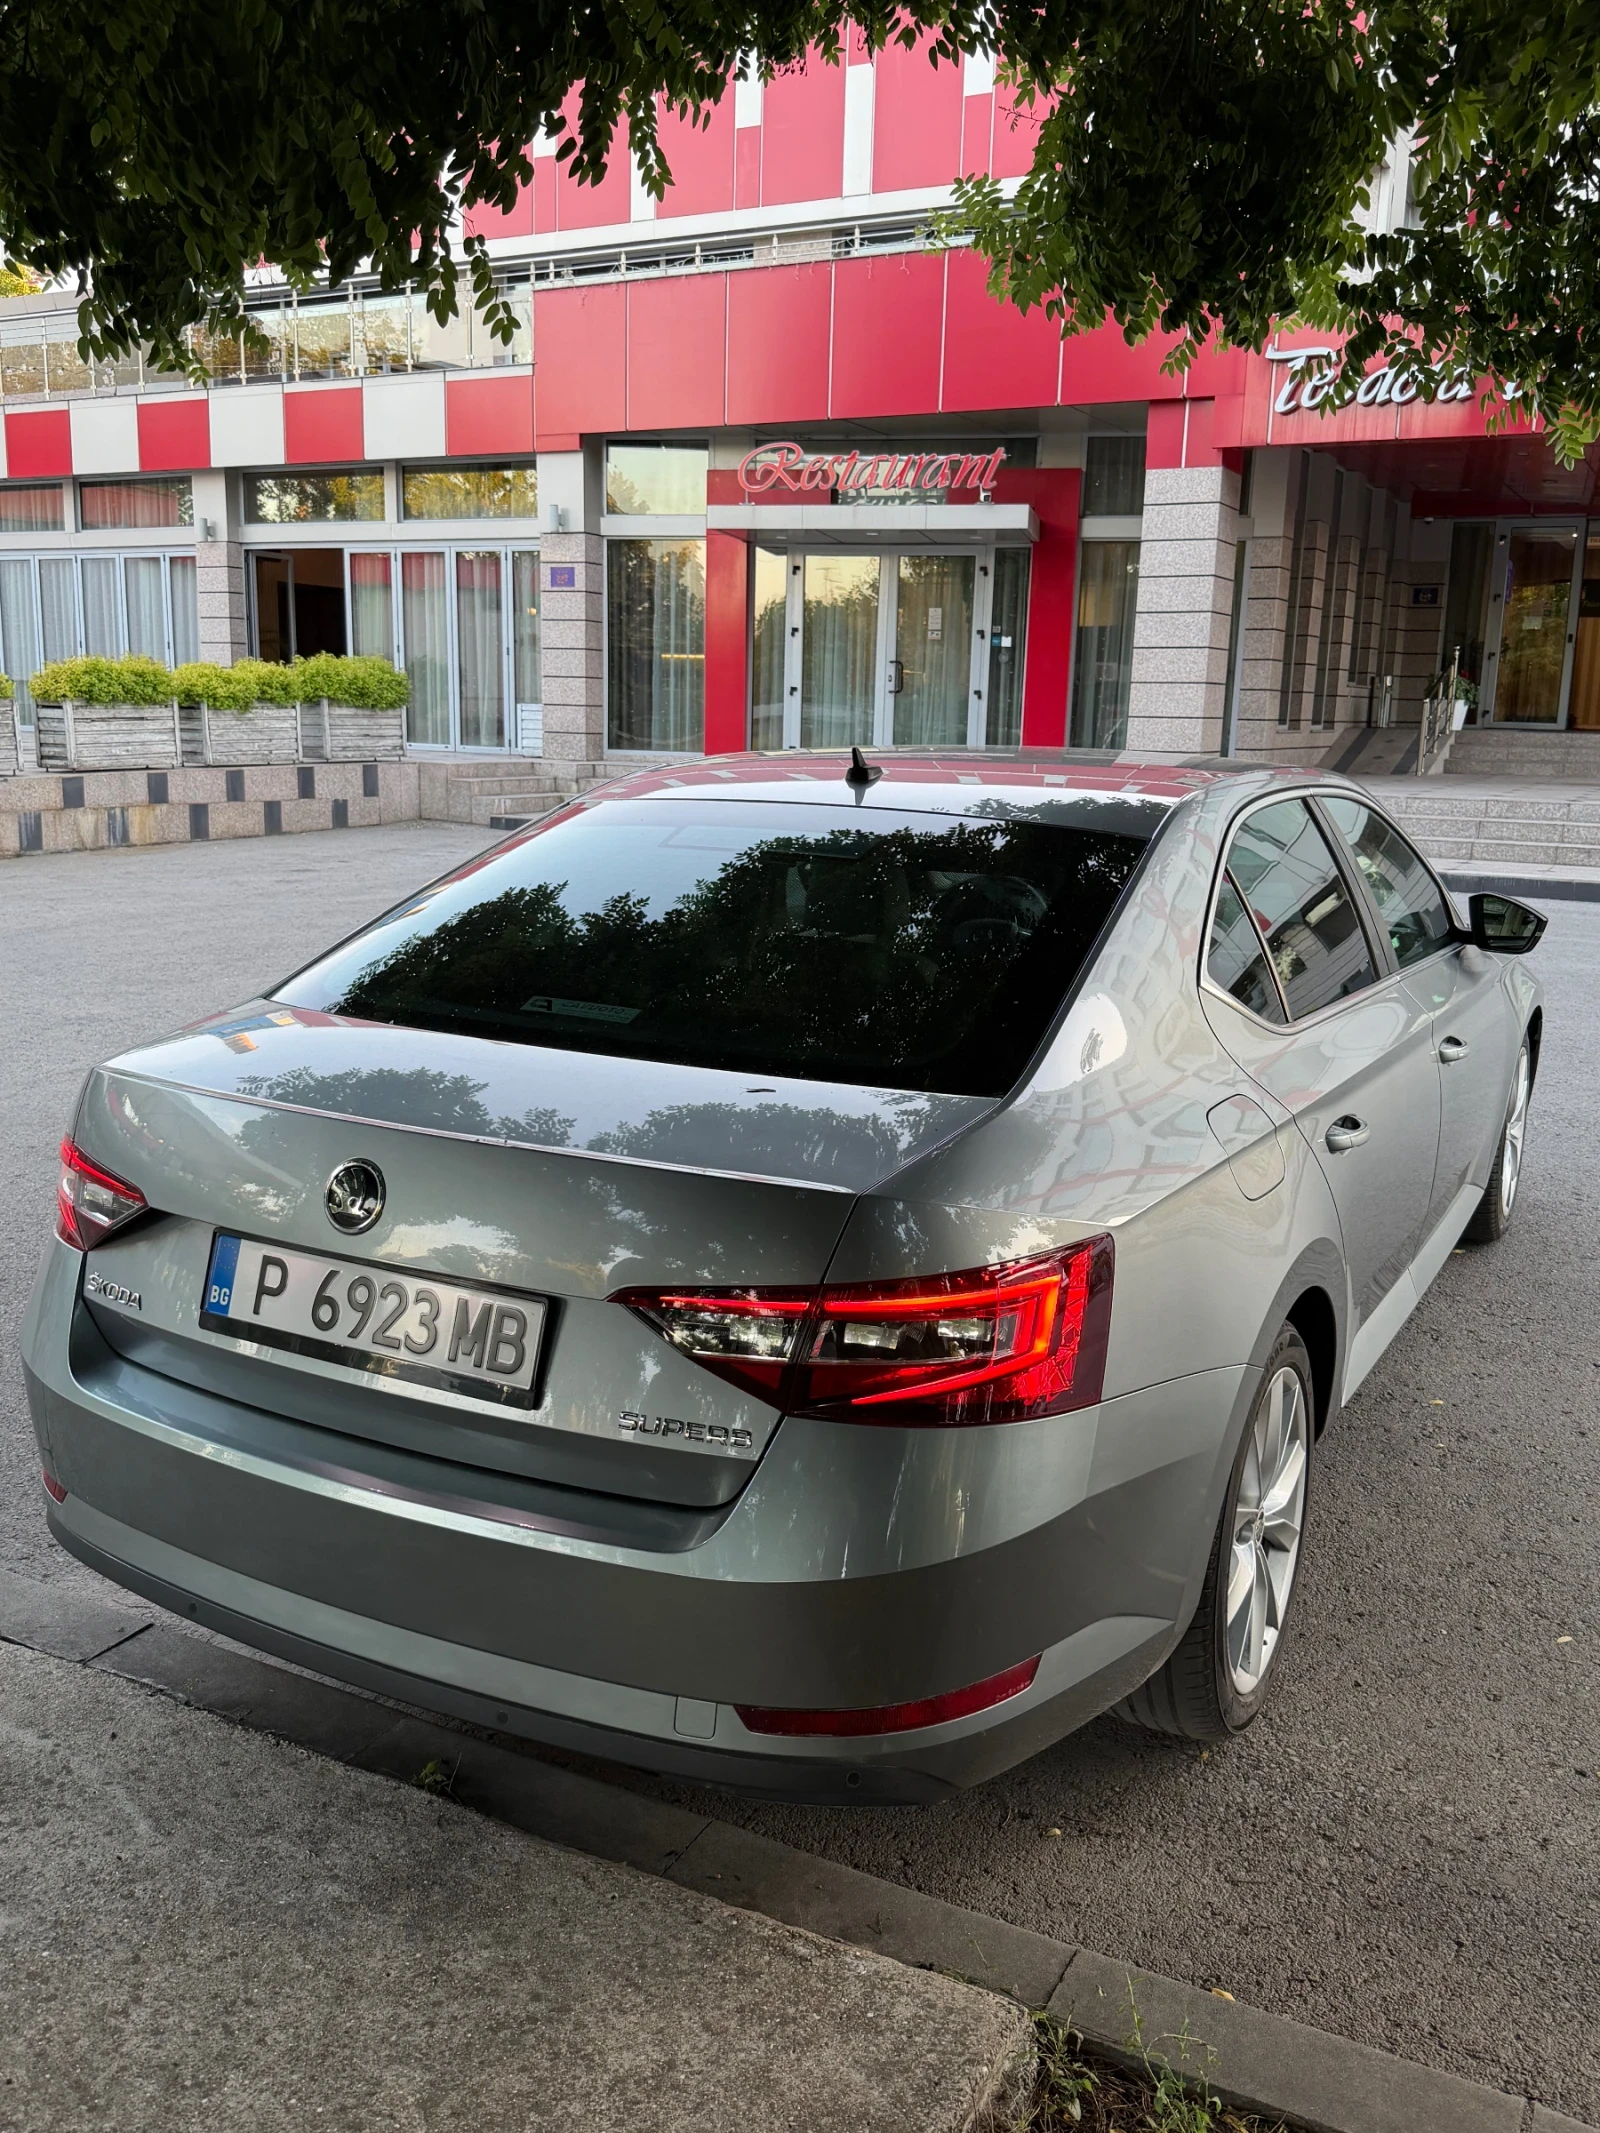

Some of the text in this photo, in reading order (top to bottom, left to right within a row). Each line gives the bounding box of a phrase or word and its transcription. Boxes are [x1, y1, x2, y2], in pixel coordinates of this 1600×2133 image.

[1265, 343, 1472, 413] Tedoa
[738, 441, 1007, 493] Restaurant
[87, 1271, 142, 1311] ŠKODA
[209, 1254, 528, 1375] BG P 6923 MB
[618, 1411, 753, 1449] SUPERB
